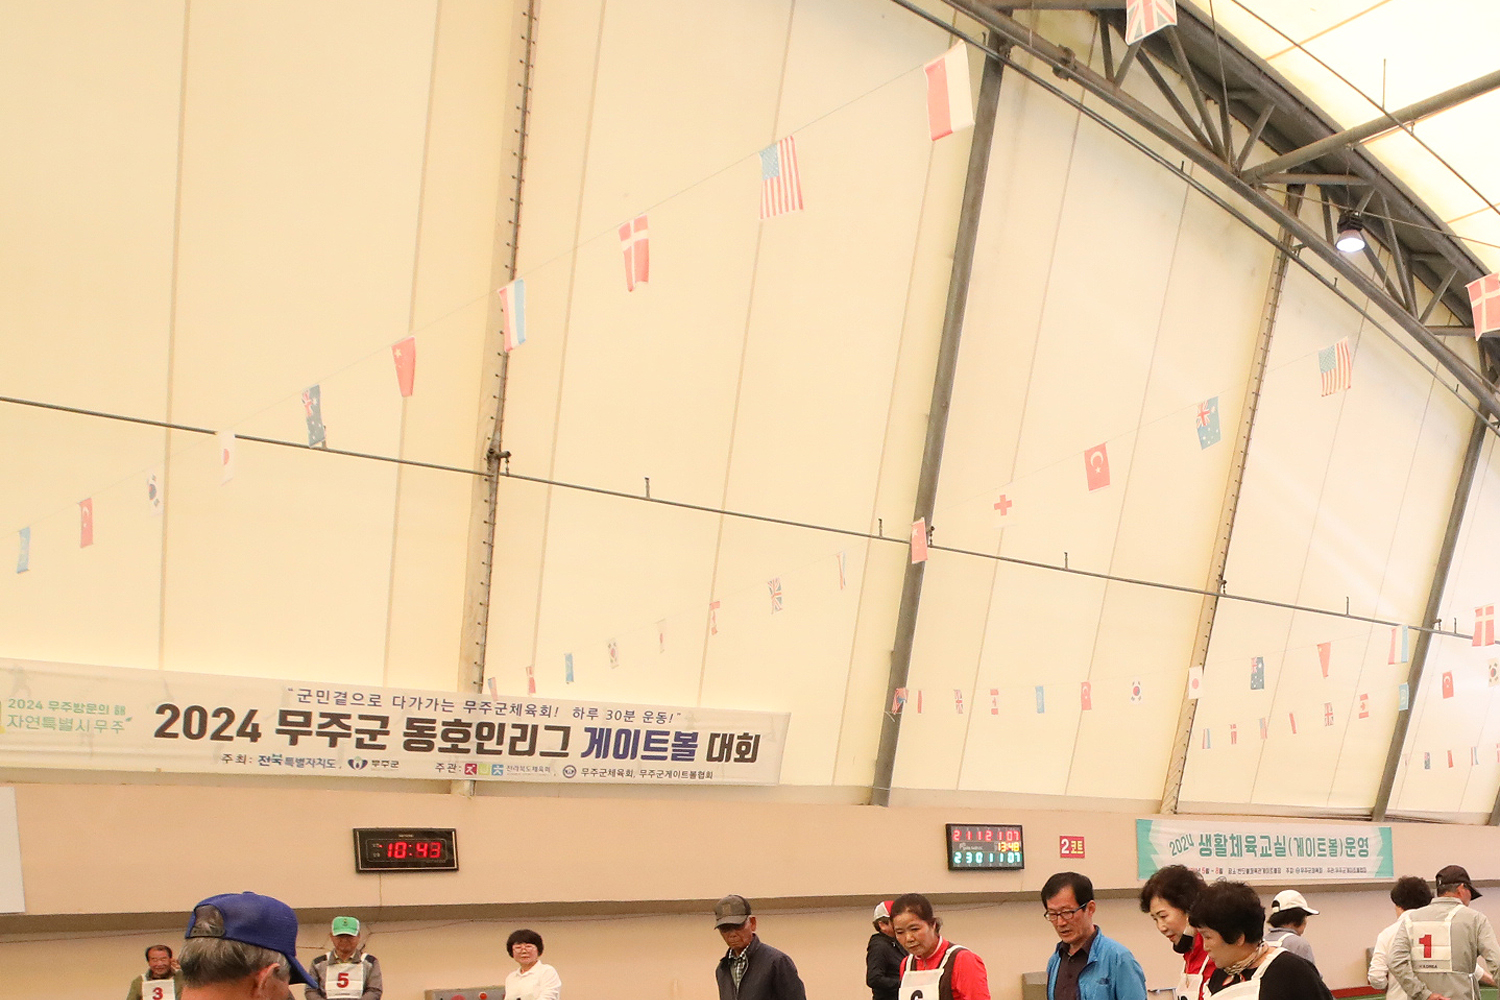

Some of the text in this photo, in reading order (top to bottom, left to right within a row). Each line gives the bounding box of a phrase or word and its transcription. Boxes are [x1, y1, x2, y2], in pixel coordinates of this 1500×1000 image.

[8, 698, 43, 710] 2024
[48, 700, 110, 715] 무주방문의
[392, 695, 455, 713] 다가가는
[463, 700, 559, 718] 무주군체육회!
[573, 706, 600, 721] 하루
[606, 709, 636, 723] 30분
[153, 703, 762, 764] 2024 무주군 동호인리그 게이트볼 대회
[1169, 833, 1195, 857] 2024
[1419, 934, 1432, 958] 1
[337, 973, 350, 988] 5
[152, 987, 163, 1000] 3
